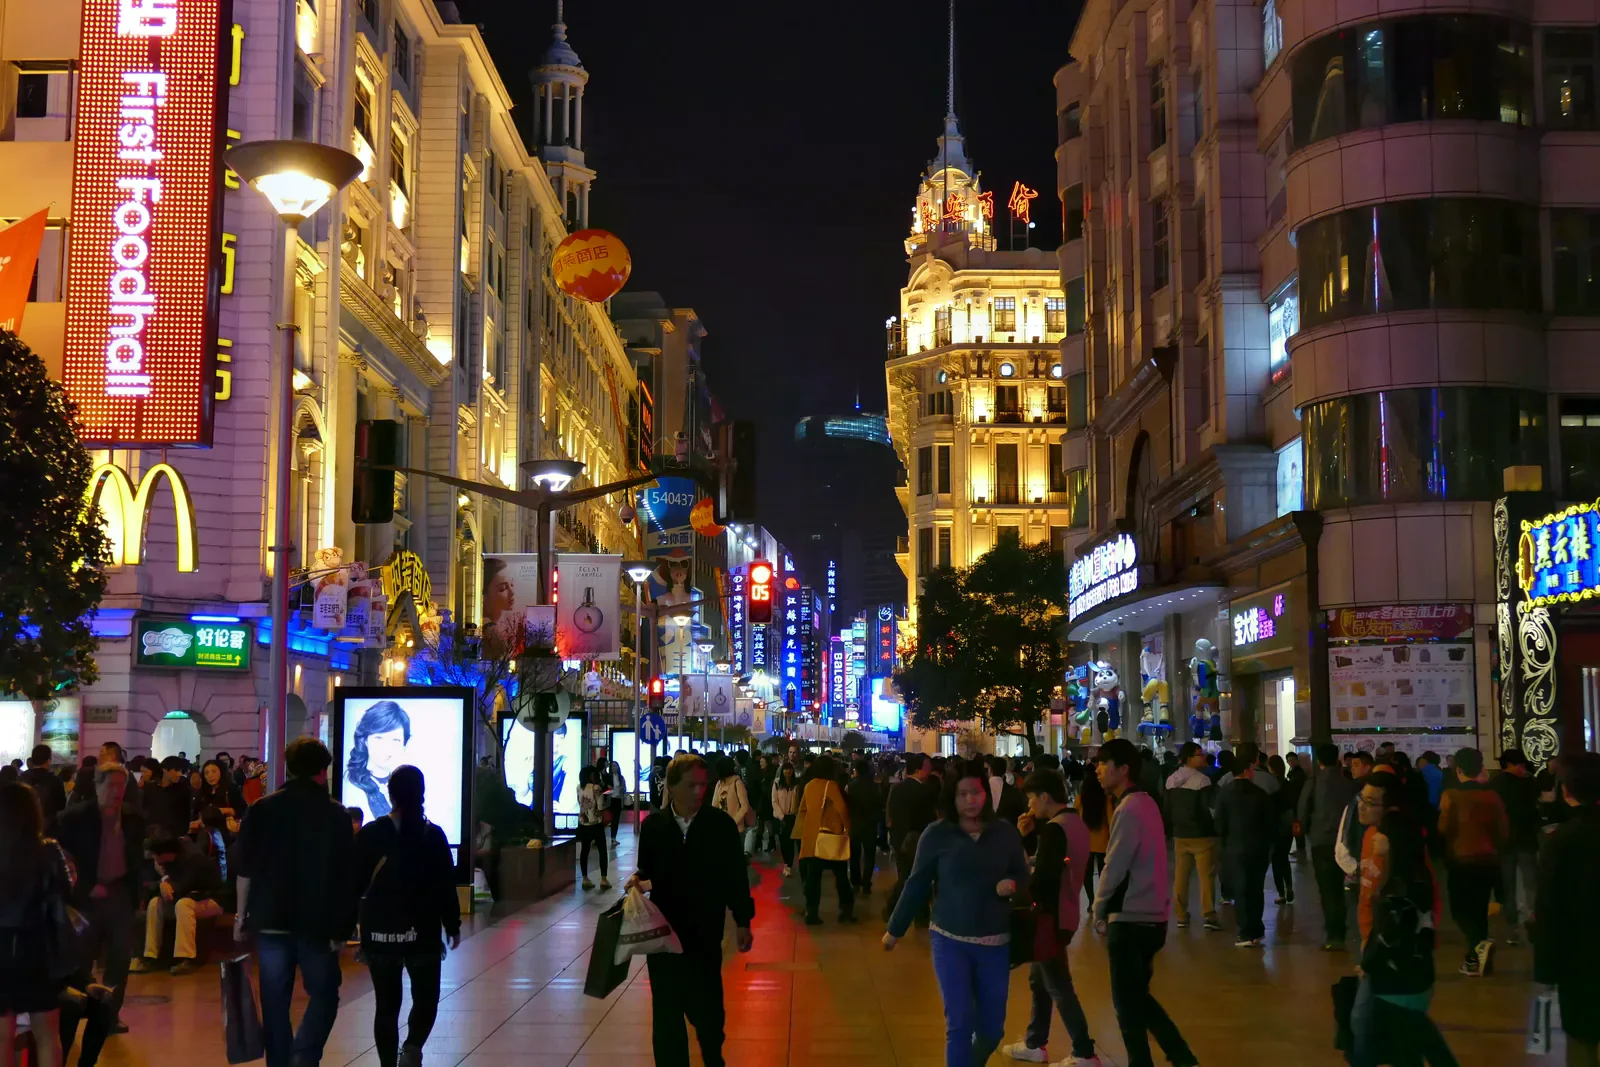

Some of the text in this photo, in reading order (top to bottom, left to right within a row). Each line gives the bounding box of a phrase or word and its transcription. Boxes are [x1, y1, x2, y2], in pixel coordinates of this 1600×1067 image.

[105, 73, 165, 397] First Foodhall
[751, 584, 770, 601] 05
[196, 627, 246, 649] 好伦哥
[370, 931, 388, 943] TIME
